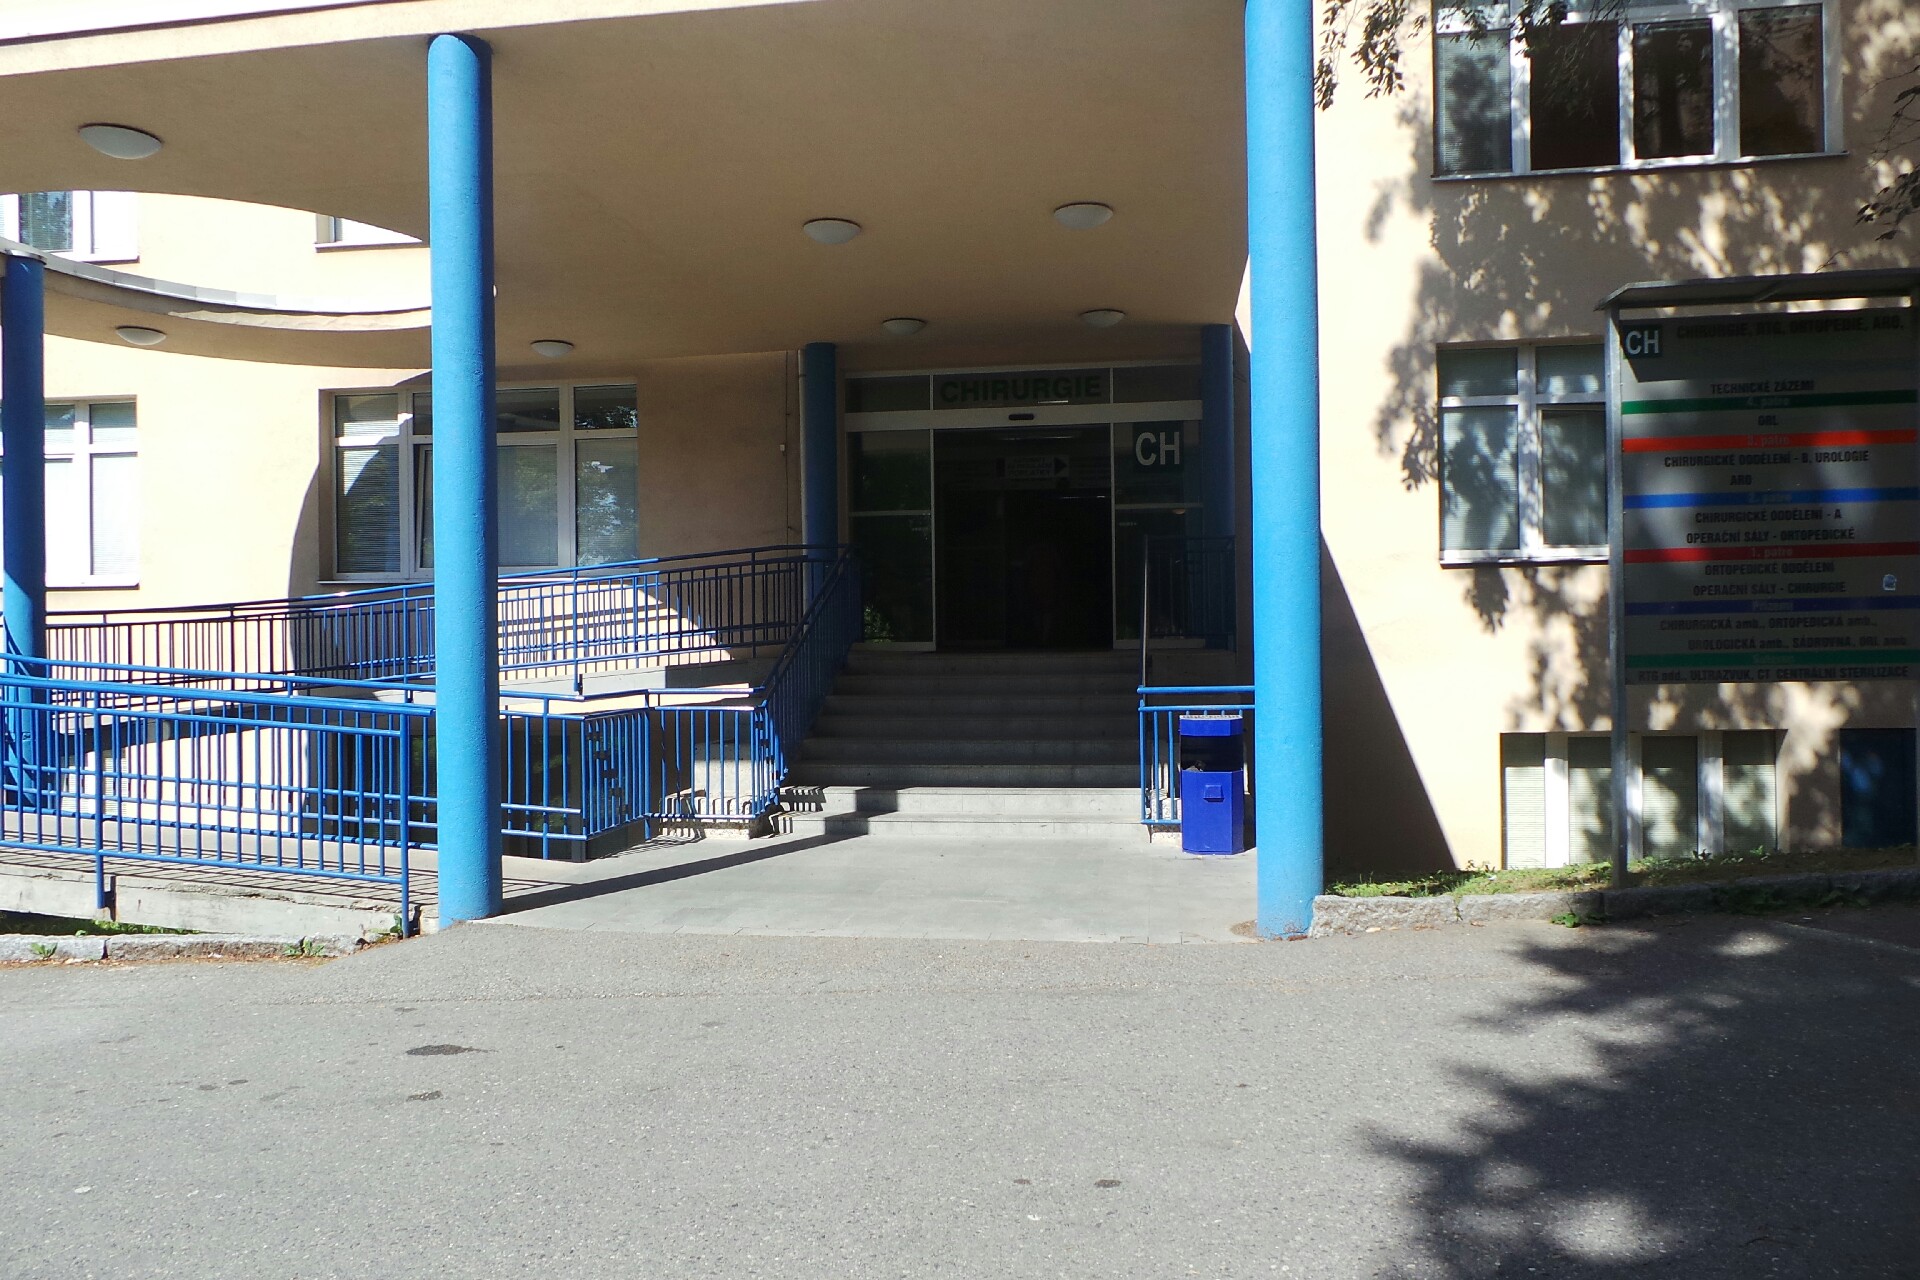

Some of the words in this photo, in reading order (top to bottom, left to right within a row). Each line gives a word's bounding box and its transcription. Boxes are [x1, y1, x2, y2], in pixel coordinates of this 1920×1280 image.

[1625, 330, 1660, 355] CH
[940, 375, 1101, 403] CHIRURGIE
[1710, 381, 1770, 394] TECHNICKÉ
[1758, 415, 1779, 426] ORL
[1135, 431, 1180, 466] CH
[1664, 453, 1735, 467] CHIRURGICKÉ
[1739, 452, 1791, 465] ODDĚLENÍ
[1815, 451, 1869, 463] UROLOGIE
[1730, 475, 1752, 486] ARO
[1695, 510, 1767, 523] CHIRURGICKÉ
[1771, 508, 1823, 521] ODDĚLENÍ
[1834, 509, 1842, 519] A
[1686, 530, 1740, 543] OPERAČNÍ
[1744, 529, 1769, 542] SÁLY
[1780, 528, 1855, 541] ORTOPEDICKÉ
[1705, 562, 1778, 575] ORTOPEDICKÉ
[1782, 561, 1834, 574] ODDĚLENÍ
[1693, 583, 1748, 596] OPERAČNÍ
[1752, 582, 1777, 595] SÁLY
[1788, 581, 1846, 594] CHIRURGIE
[1660, 617, 1732, 630] CHIRURGICKÁ
[1769, 616, 1844, 629] ORTOPEDICKÁ
[1840, 666, 1909, 679] STERILIZACE
